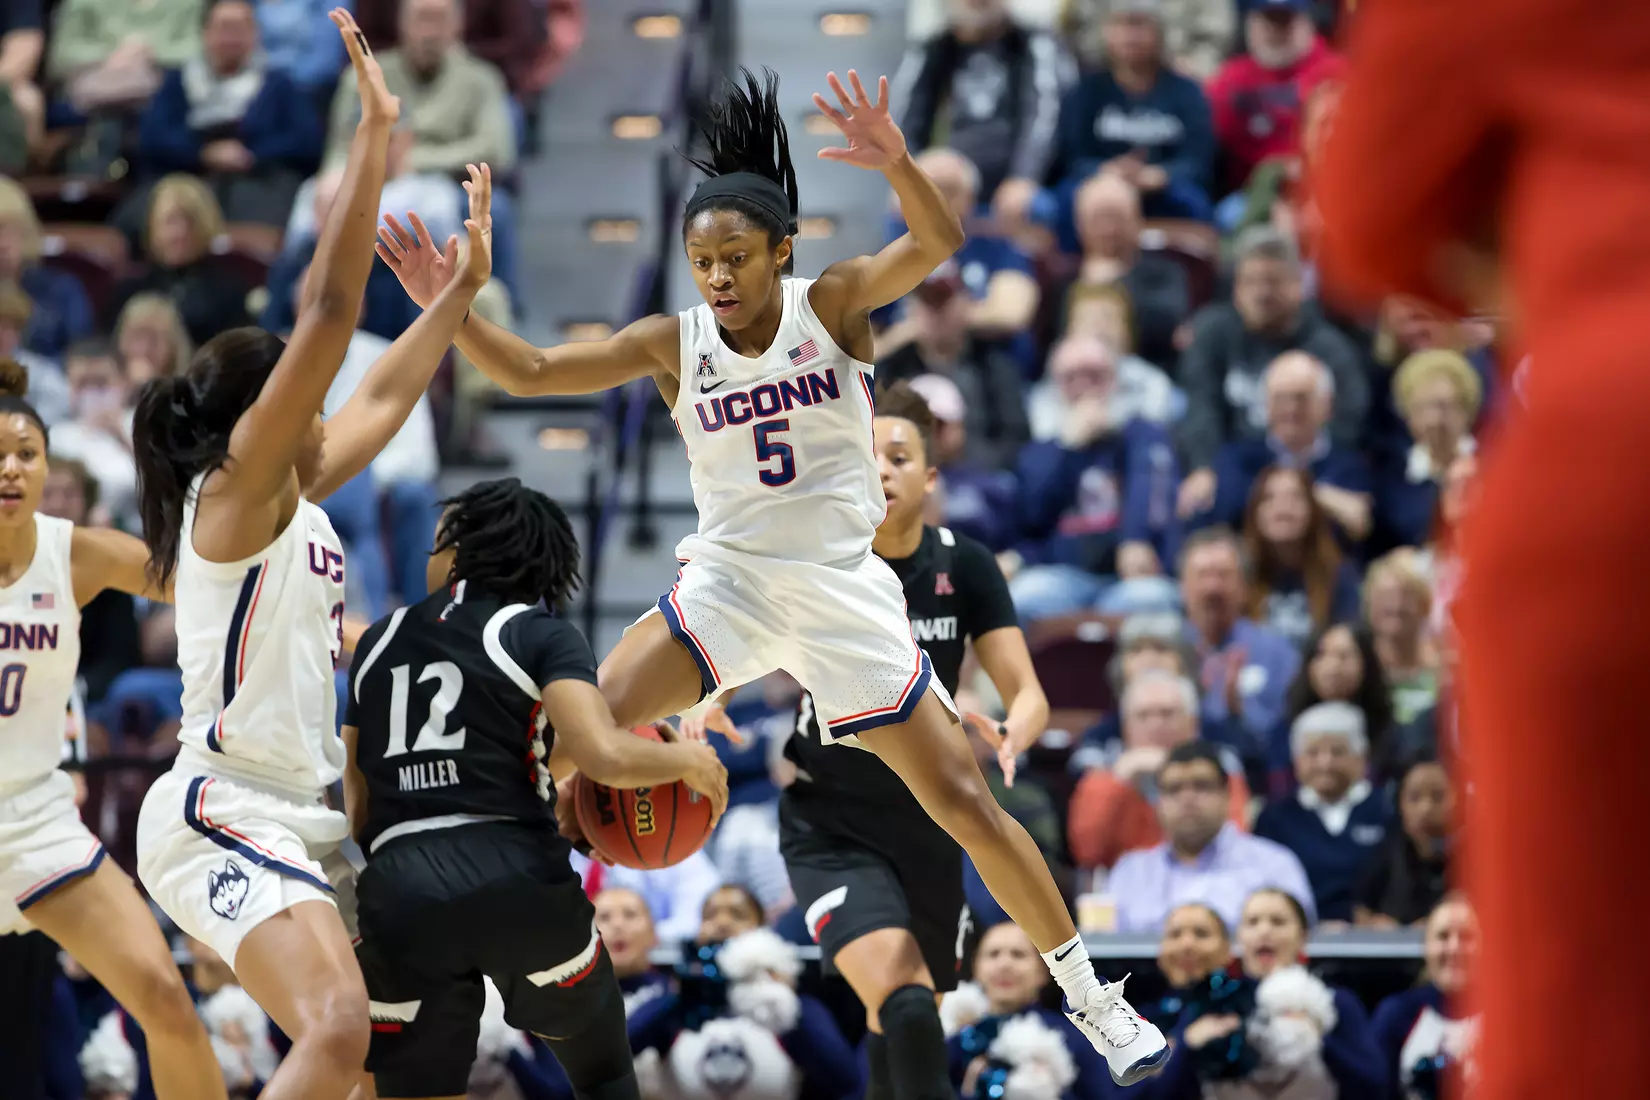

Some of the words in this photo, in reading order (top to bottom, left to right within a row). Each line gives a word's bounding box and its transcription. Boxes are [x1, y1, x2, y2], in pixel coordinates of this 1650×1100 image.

[695, 368, 841, 432] UCONN
[753, 418, 797, 487] 5
[383, 661, 467, 758] 12
[398, 759, 460, 791] MILLER
